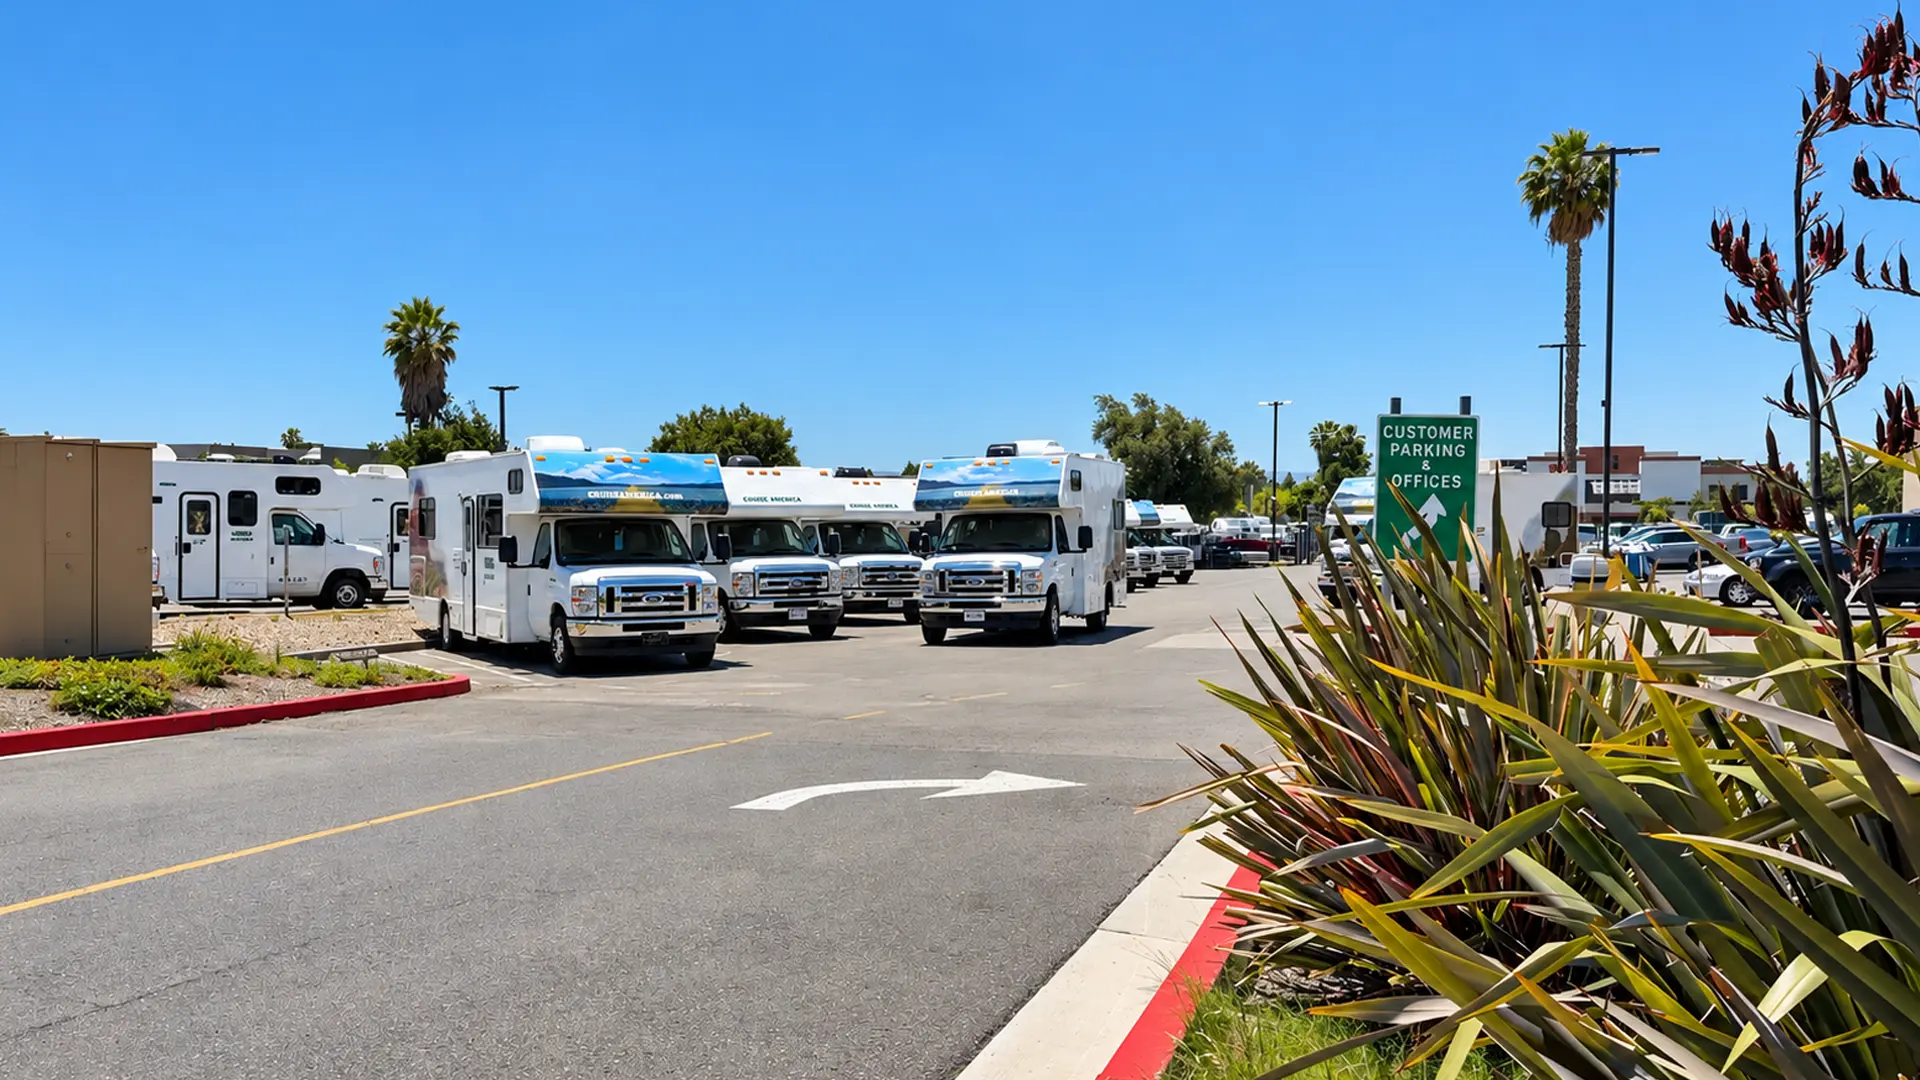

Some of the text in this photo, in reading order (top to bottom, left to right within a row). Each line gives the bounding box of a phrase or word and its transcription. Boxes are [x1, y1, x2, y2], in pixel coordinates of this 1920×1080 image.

[1383, 425, 1473, 440] CUSTOMER
[1390, 443, 1466, 457] PARKING
[1421, 460, 1431, 470] &
[1391, 474, 1461, 488] OFFICES
